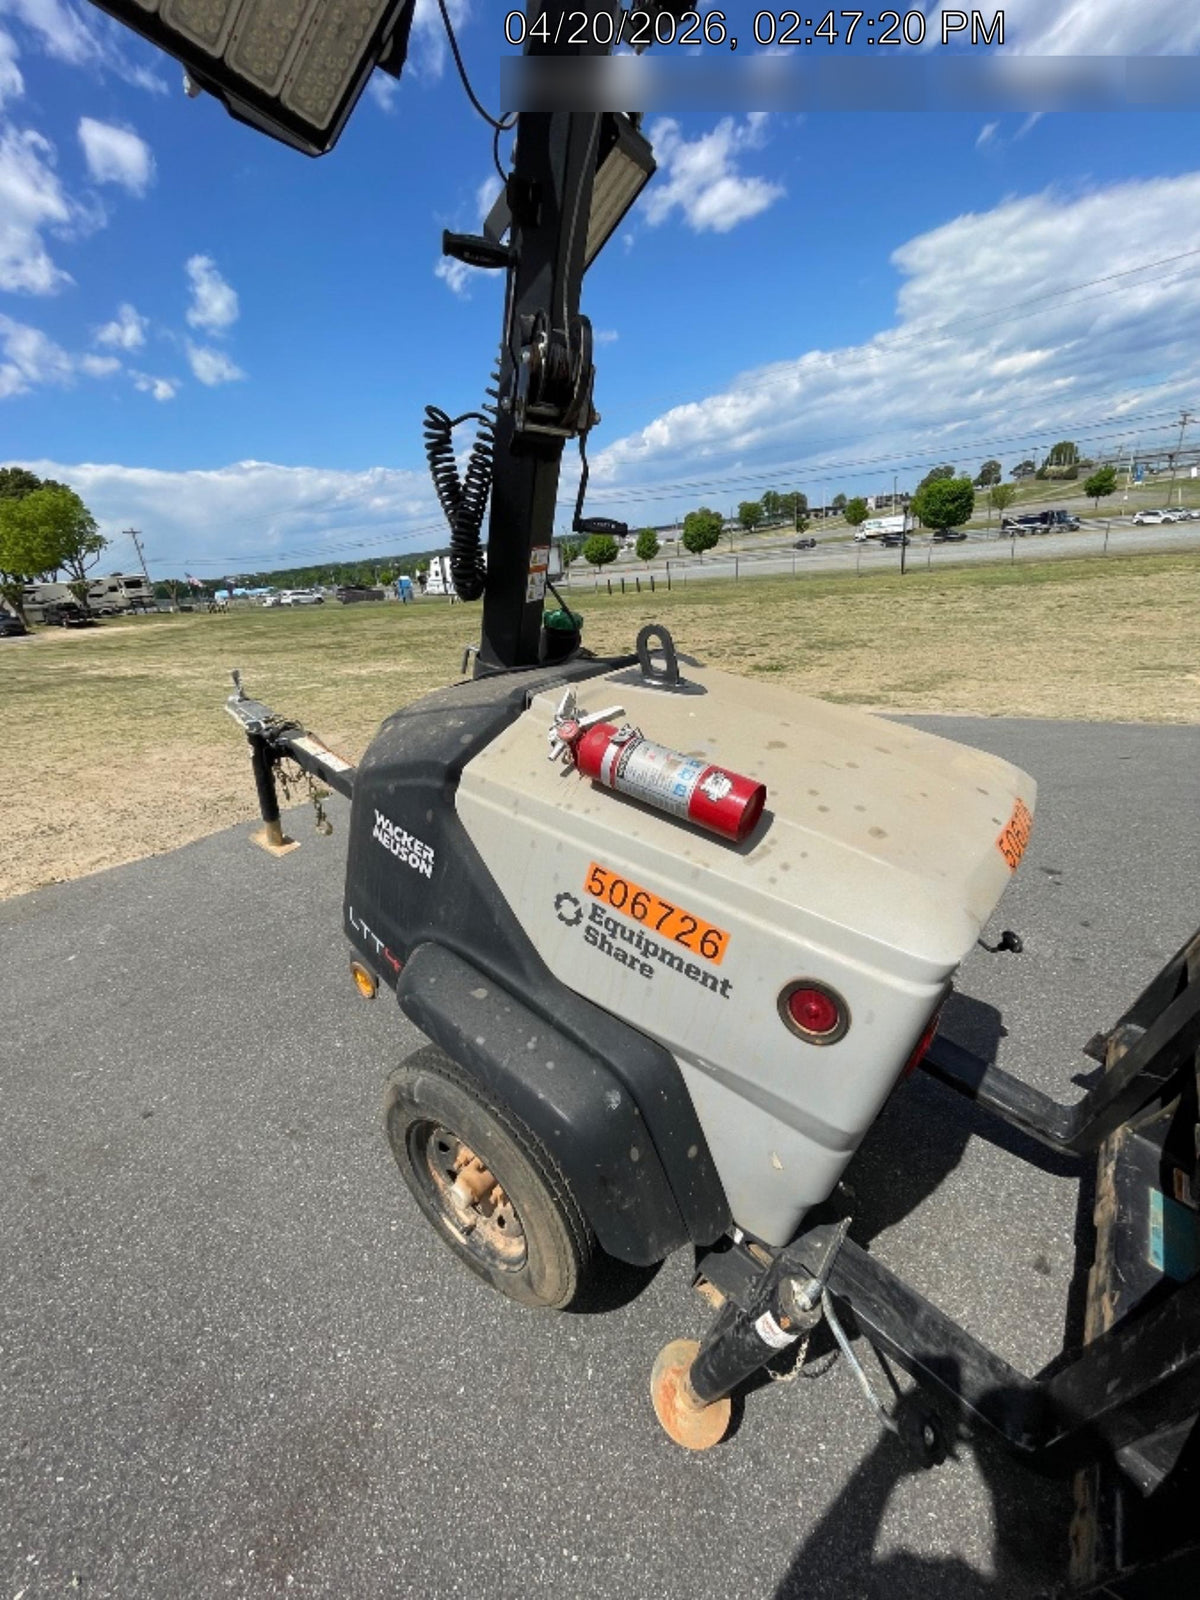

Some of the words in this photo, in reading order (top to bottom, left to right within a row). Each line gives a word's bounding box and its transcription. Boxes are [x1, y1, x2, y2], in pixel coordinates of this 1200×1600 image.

[372, 825, 434, 880] NEUSON
[373, 809, 436, 865] WACKER
[587, 866, 724, 960] 506726
[583, 925, 656, 980] Share
[588, 902, 734, 999] Equipment
